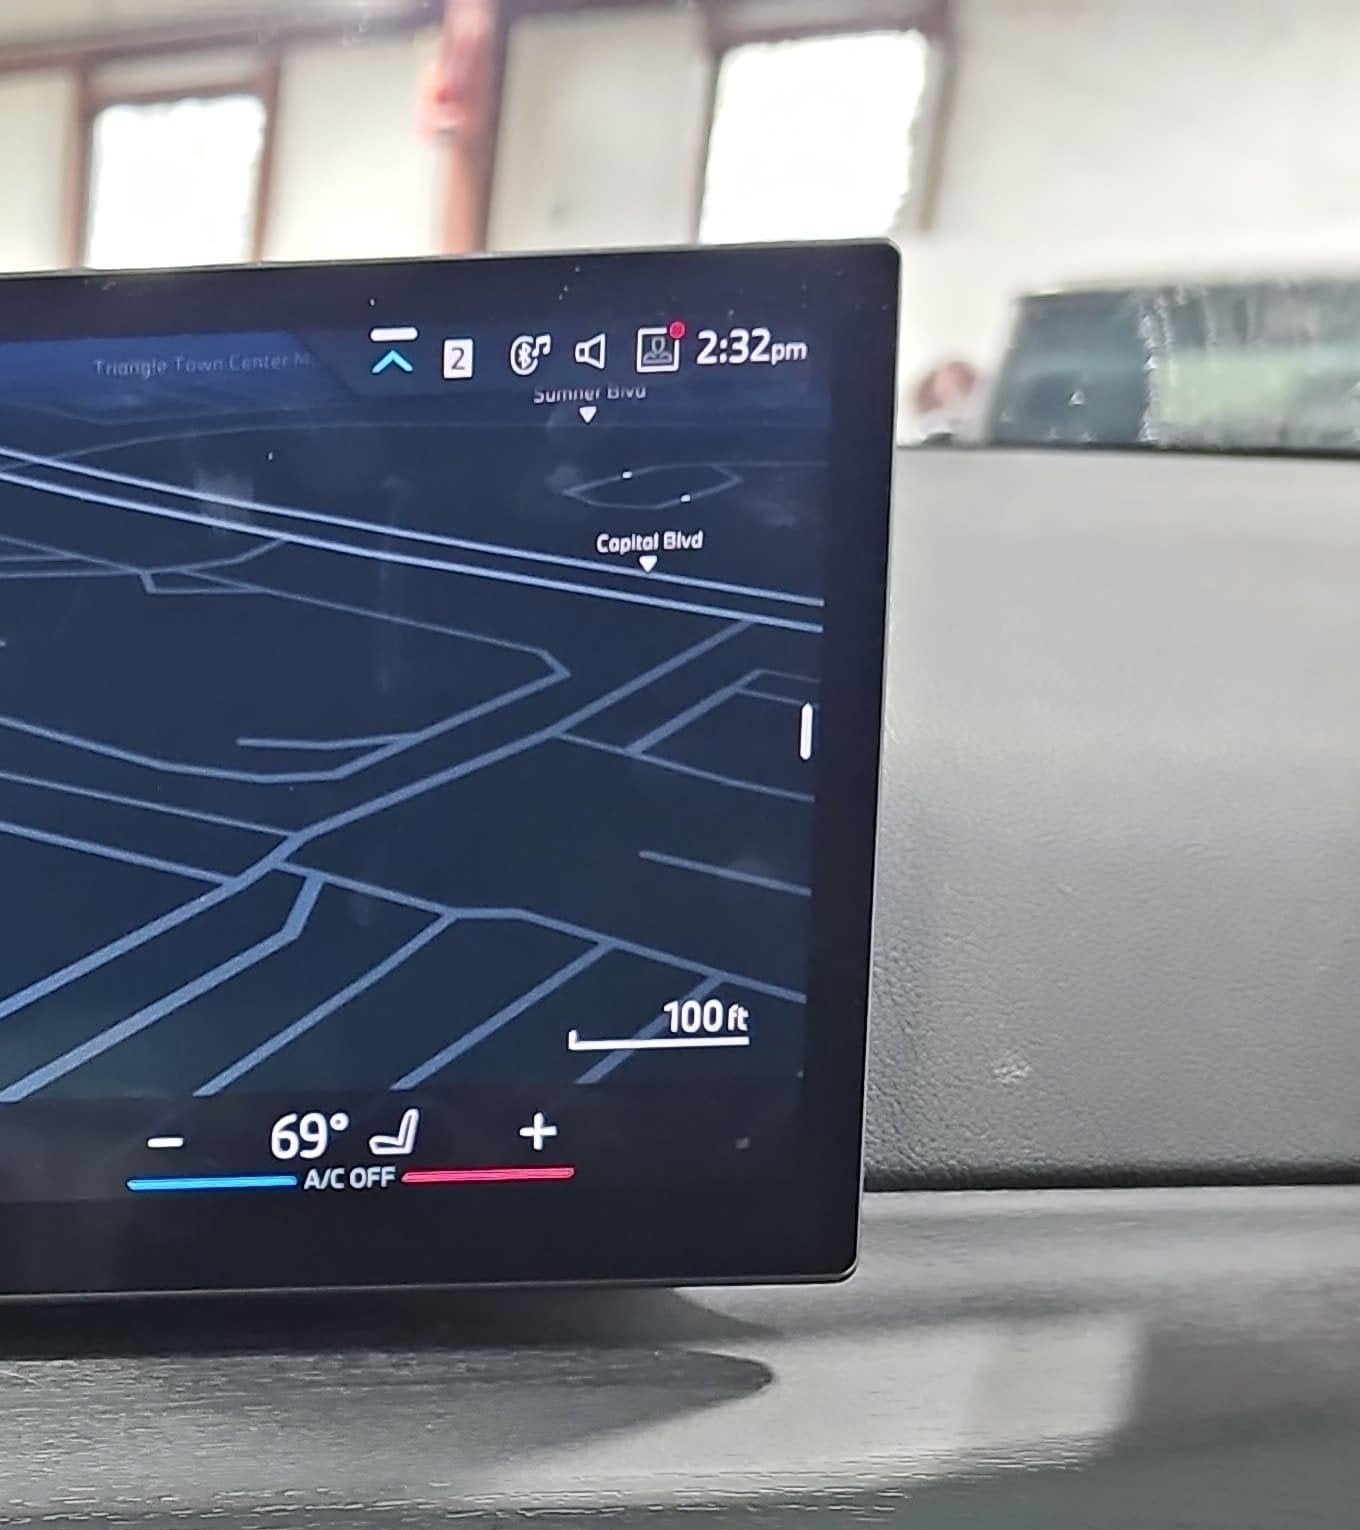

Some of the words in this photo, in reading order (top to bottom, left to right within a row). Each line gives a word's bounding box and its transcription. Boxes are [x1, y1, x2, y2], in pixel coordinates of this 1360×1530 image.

[449, 346, 466, 371] 2
[696, 327, 808, 366] 2:32pm
[93, 358, 168, 379] Triangle
[175, 355, 223, 373] Town
[229, 351, 289, 371] Center
[596, 532, 659, 556] Capital
[663, 529, 704, 550] Blvd
[271, 1111, 350, 1160] 69°
[303, 1167, 346, 1190] A/C
[349, 1165, 397, 1189] OFF
